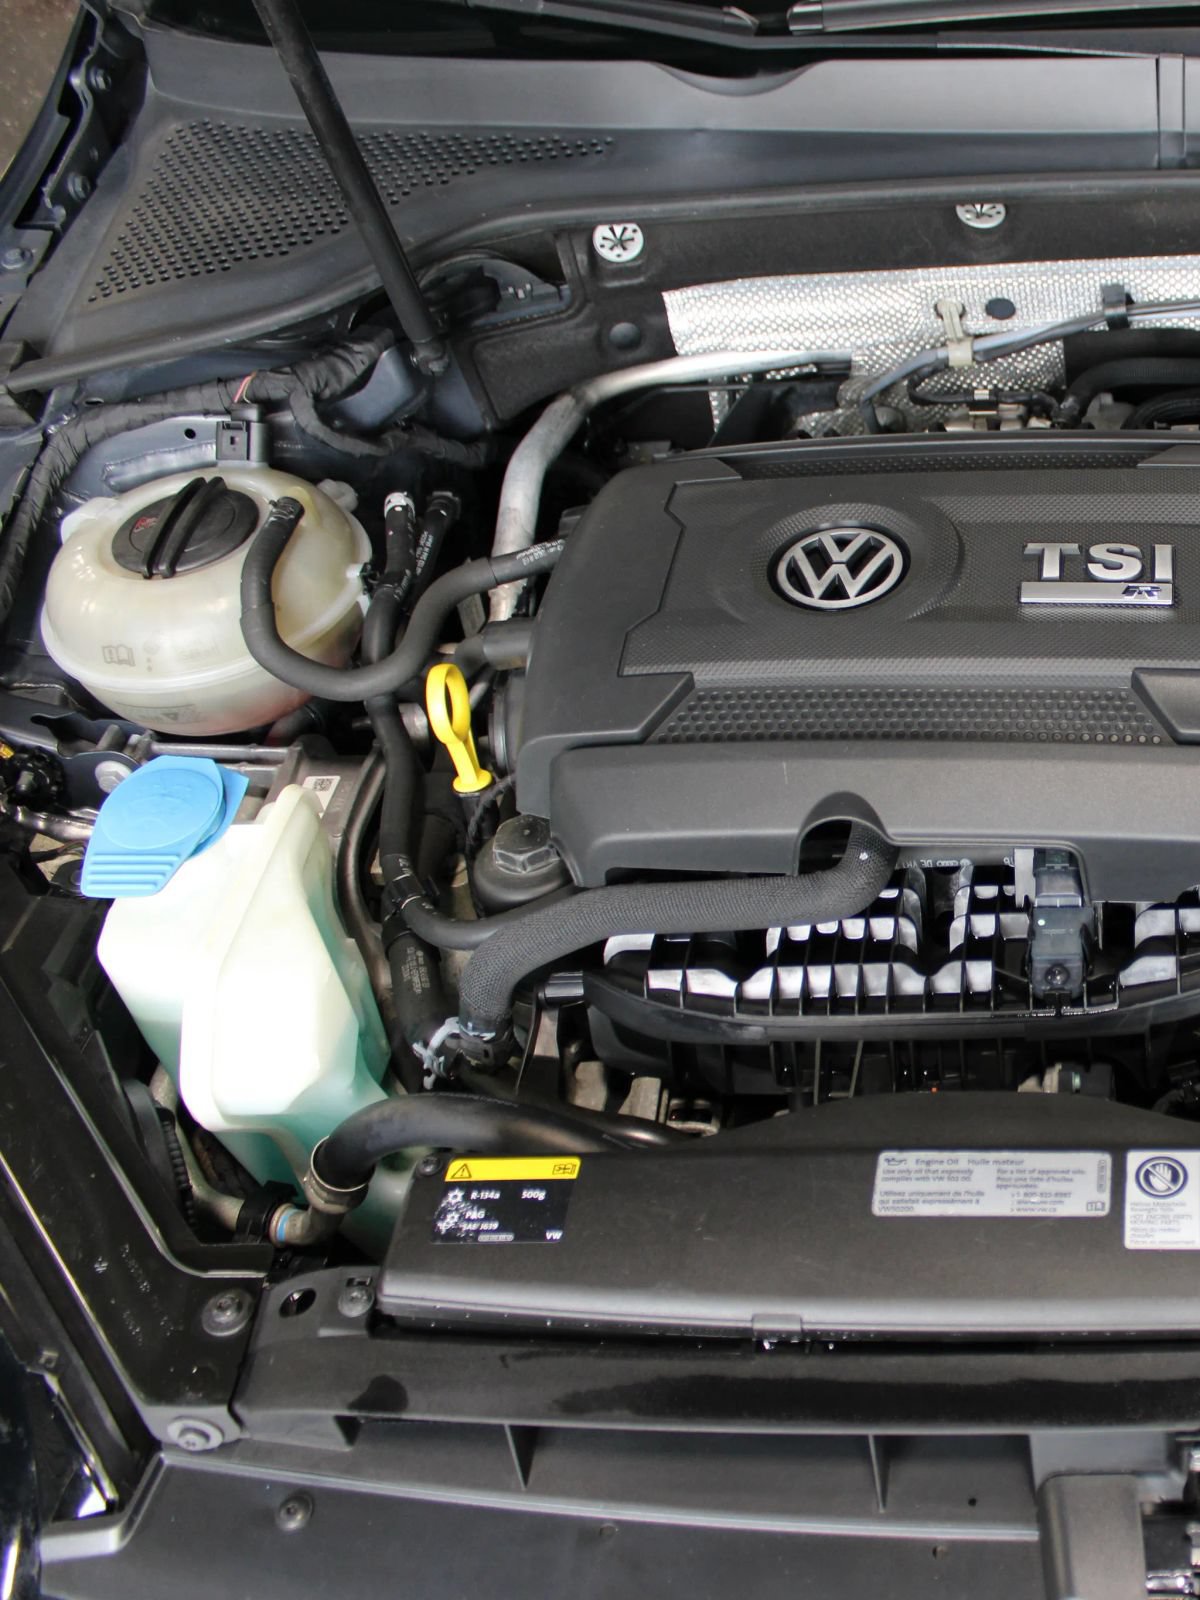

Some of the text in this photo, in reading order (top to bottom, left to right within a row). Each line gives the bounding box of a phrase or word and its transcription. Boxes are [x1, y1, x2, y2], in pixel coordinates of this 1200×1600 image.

[1024, 543, 1173, 582] TSI
[915, 1158, 945, 1167] Engine
[946, 1158, 959, 1166] Oil
[470, 1189, 546, 1201] R-134a 500g
[464, 1208, 486, 1220] PAG
[546, 1230, 563, 1240] VW
